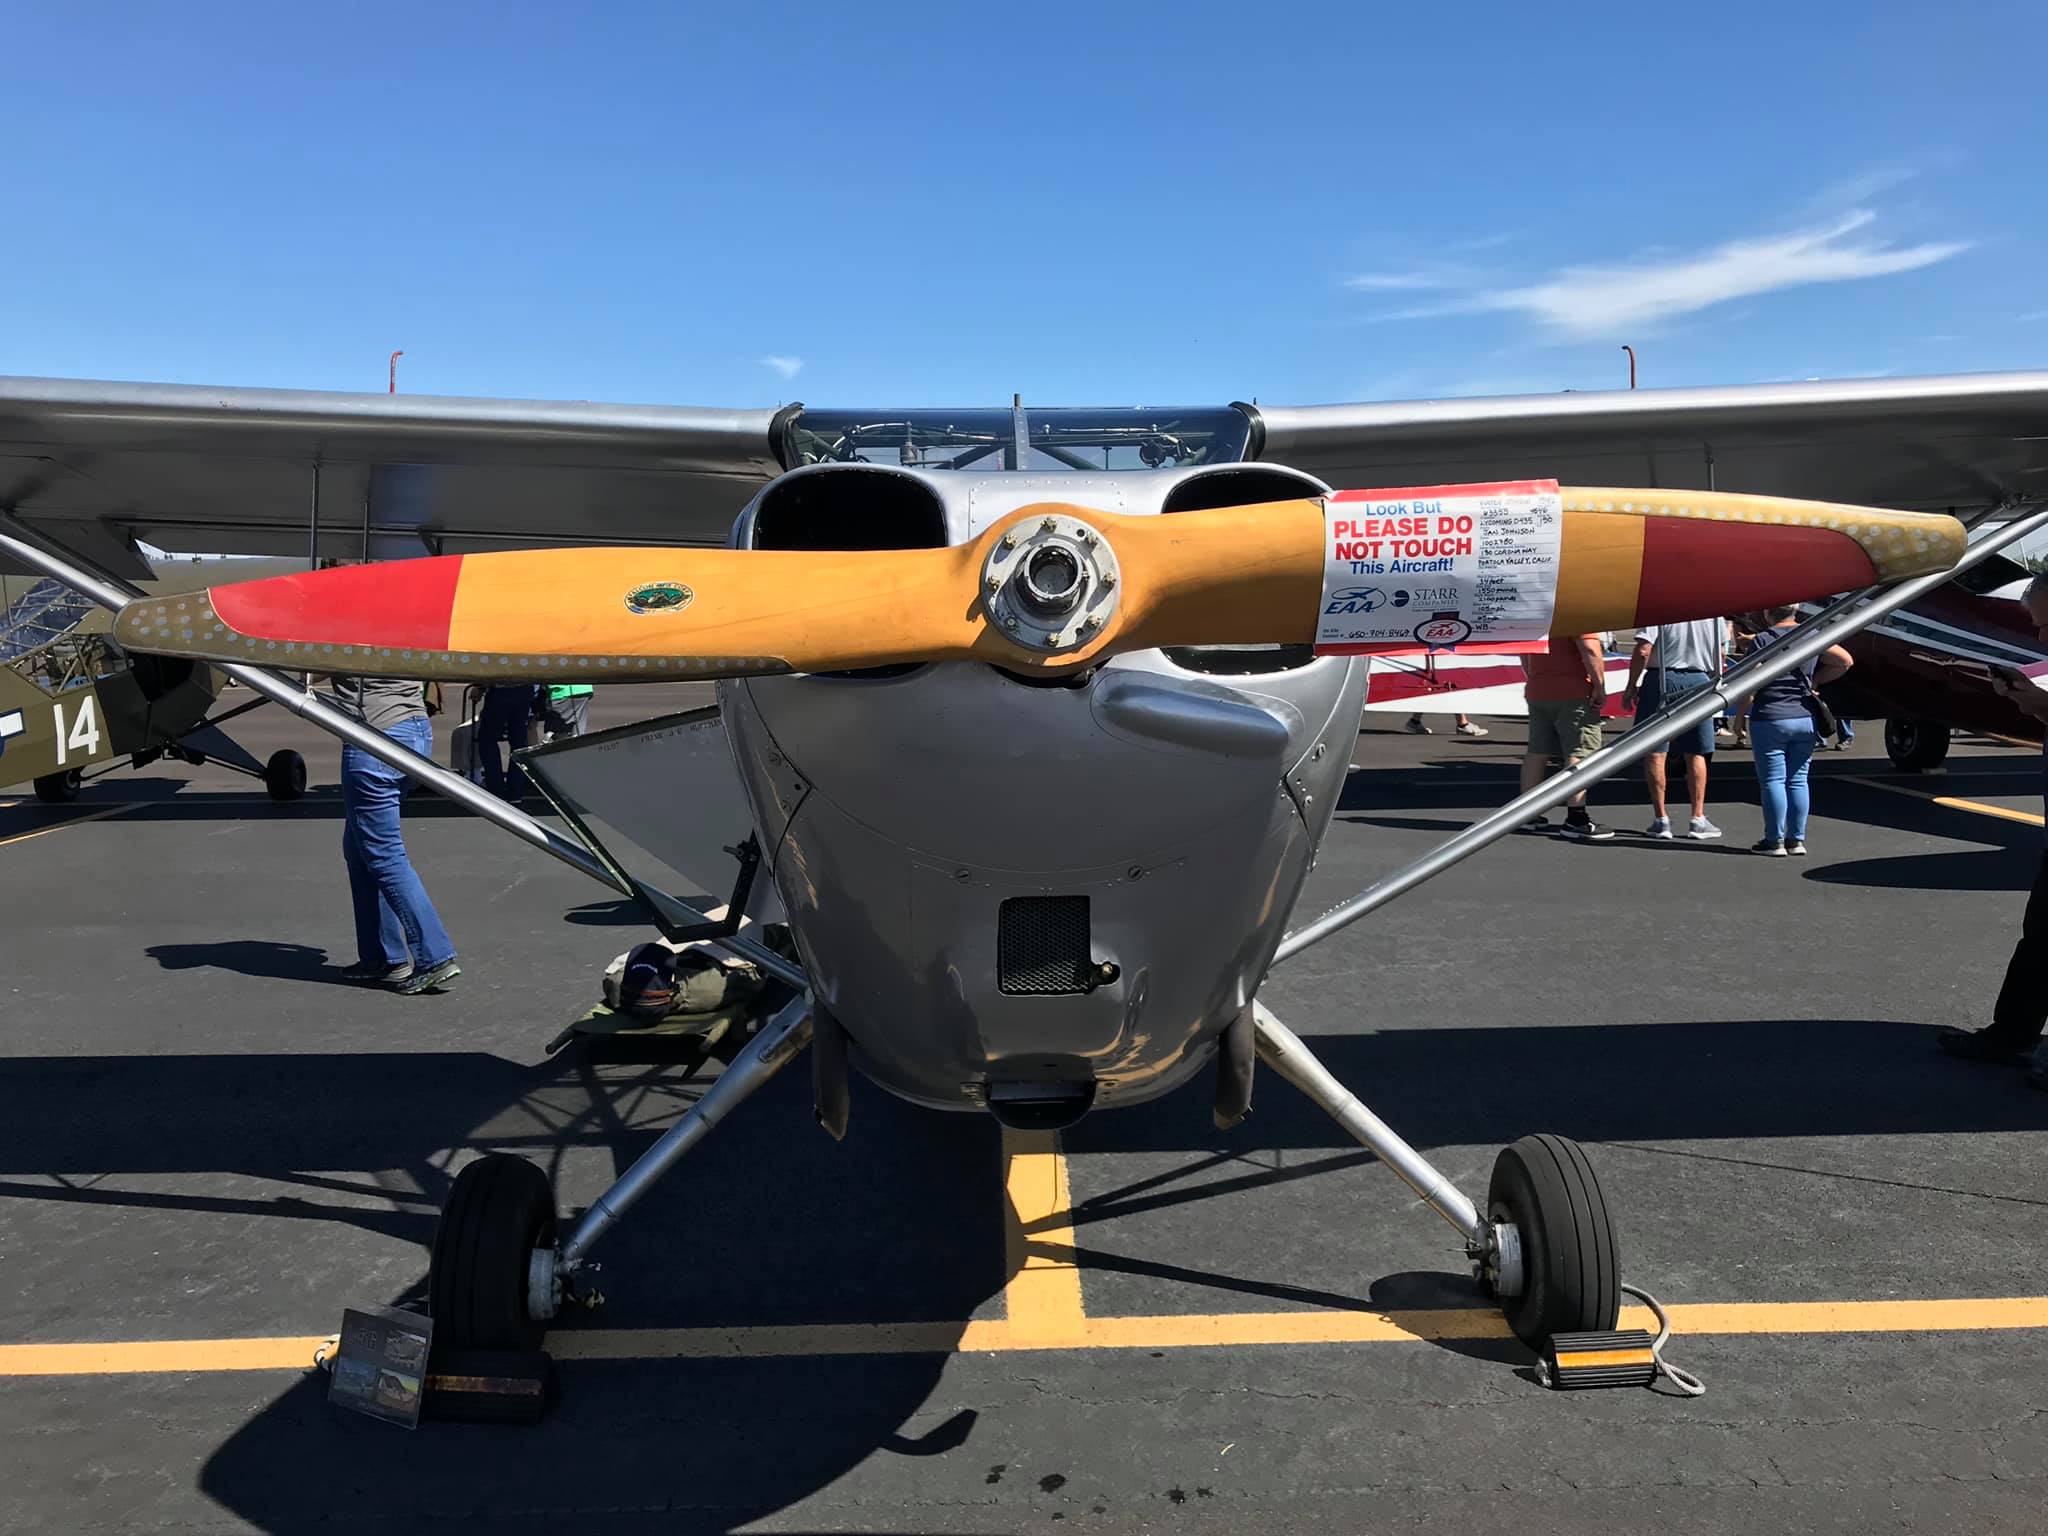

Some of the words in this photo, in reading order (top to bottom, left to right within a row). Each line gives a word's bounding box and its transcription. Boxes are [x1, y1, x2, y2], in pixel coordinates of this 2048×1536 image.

[1366, 503, 1408, 516] Look
[1413, 501, 1442, 515] But
[1334, 518, 1429, 539] PLEASE
[1437, 515, 1473, 535] DO
[1500, 527, 1535, 536] JOHNSON
[1335, 541, 1383, 561] NOT
[1389, 537, 1473, 558] TOUCH
[1350, 561, 1385, 575] This
[1389, 558, 1454, 574] Aircraft!
[1413, 587, 1459, 601] STARR
[1323, 600, 1374, 615] EAA
[1412, 599, 1459, 607] COMPANIES
[1425, 628, 1456, 638] EAA
[53, 695, 99, 765] 14
